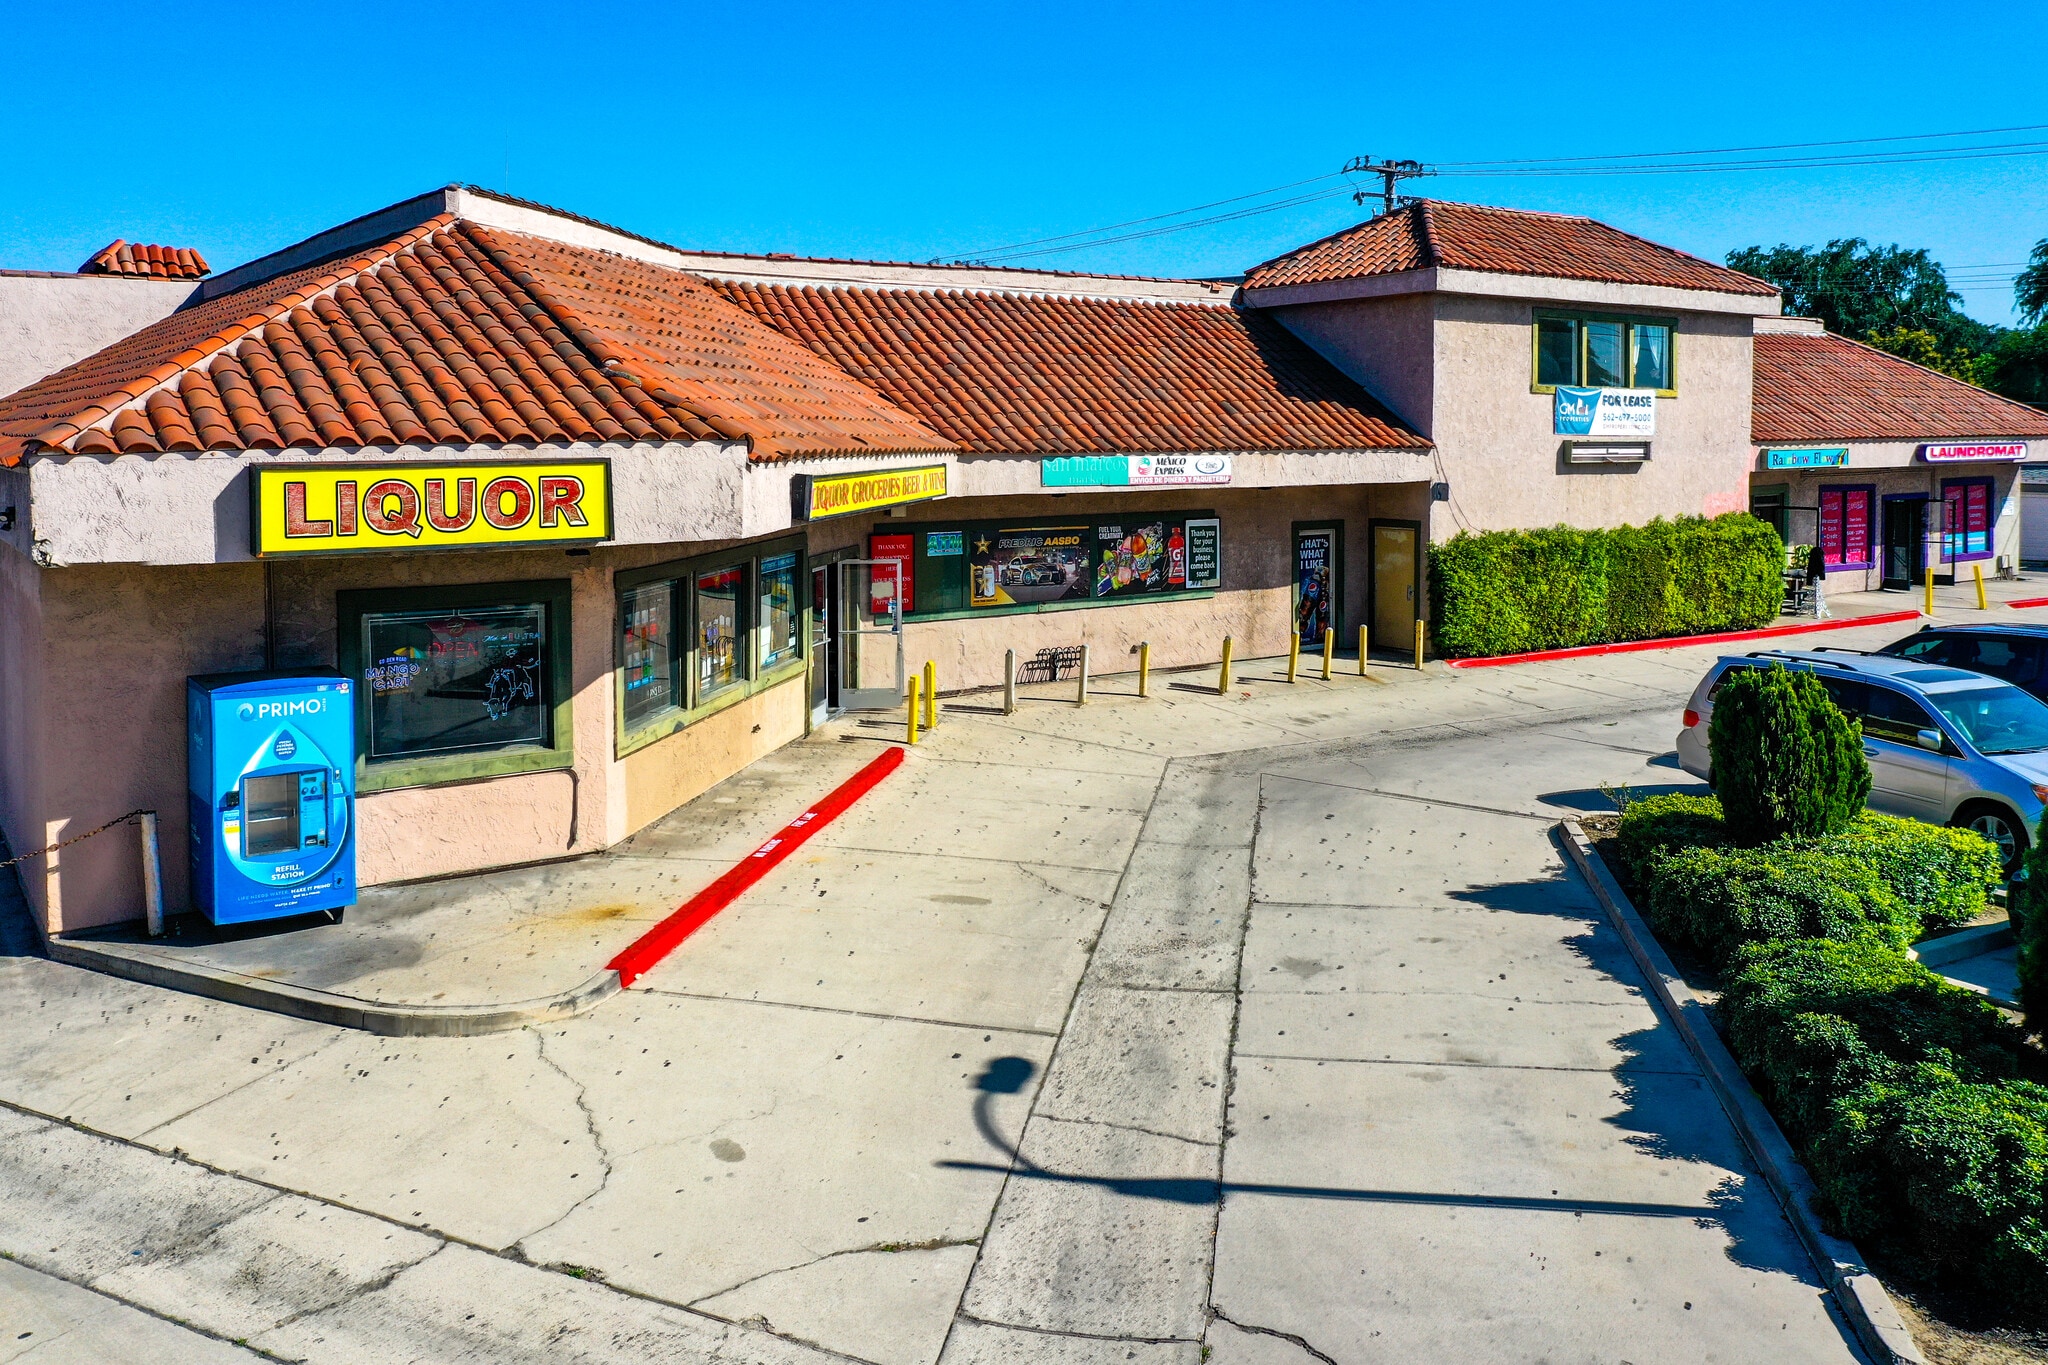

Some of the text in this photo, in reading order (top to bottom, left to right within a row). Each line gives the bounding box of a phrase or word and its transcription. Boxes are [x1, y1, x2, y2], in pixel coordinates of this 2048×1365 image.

[1602, 395, 1652, 407] FOR LEASE
[1929, 444, 2023, 459] LAUNDROMAT
[1772, 453, 1809, 466] Rainbow
[1154, 467, 1185, 475] EXPRESS
[1164, 476, 1187, 484] DINERO
[811, 471, 945, 511] LIQUOR GROCERIES BEER & WINE
[284, 475, 589, 539] LIQUOR
[1206, 531, 1215, 539] you
[928, 535, 962, 549] ATM
[998, 538, 1043, 548] FREDRIC
[1043, 536, 1080, 546] AASBO
[1195, 553, 1211, 562] please
[1300, 549, 1325, 559] WHAT
[1204, 561, 1215, 569] back
[1300, 559, 1324, 570] I LIKE
[1196, 569, 1209, 577] soon!
[427, 641, 479, 658] OPEN
[365, 663, 420, 681] MANGO
[373, 676, 411, 691] CART
[258, 698, 321, 719] PRIMO
[275, 864, 301, 873] REFILL
[271, 870, 305, 881] STATION
[250, 892, 269, 900] NEEDS
[290, 886, 307, 894] MAKE
